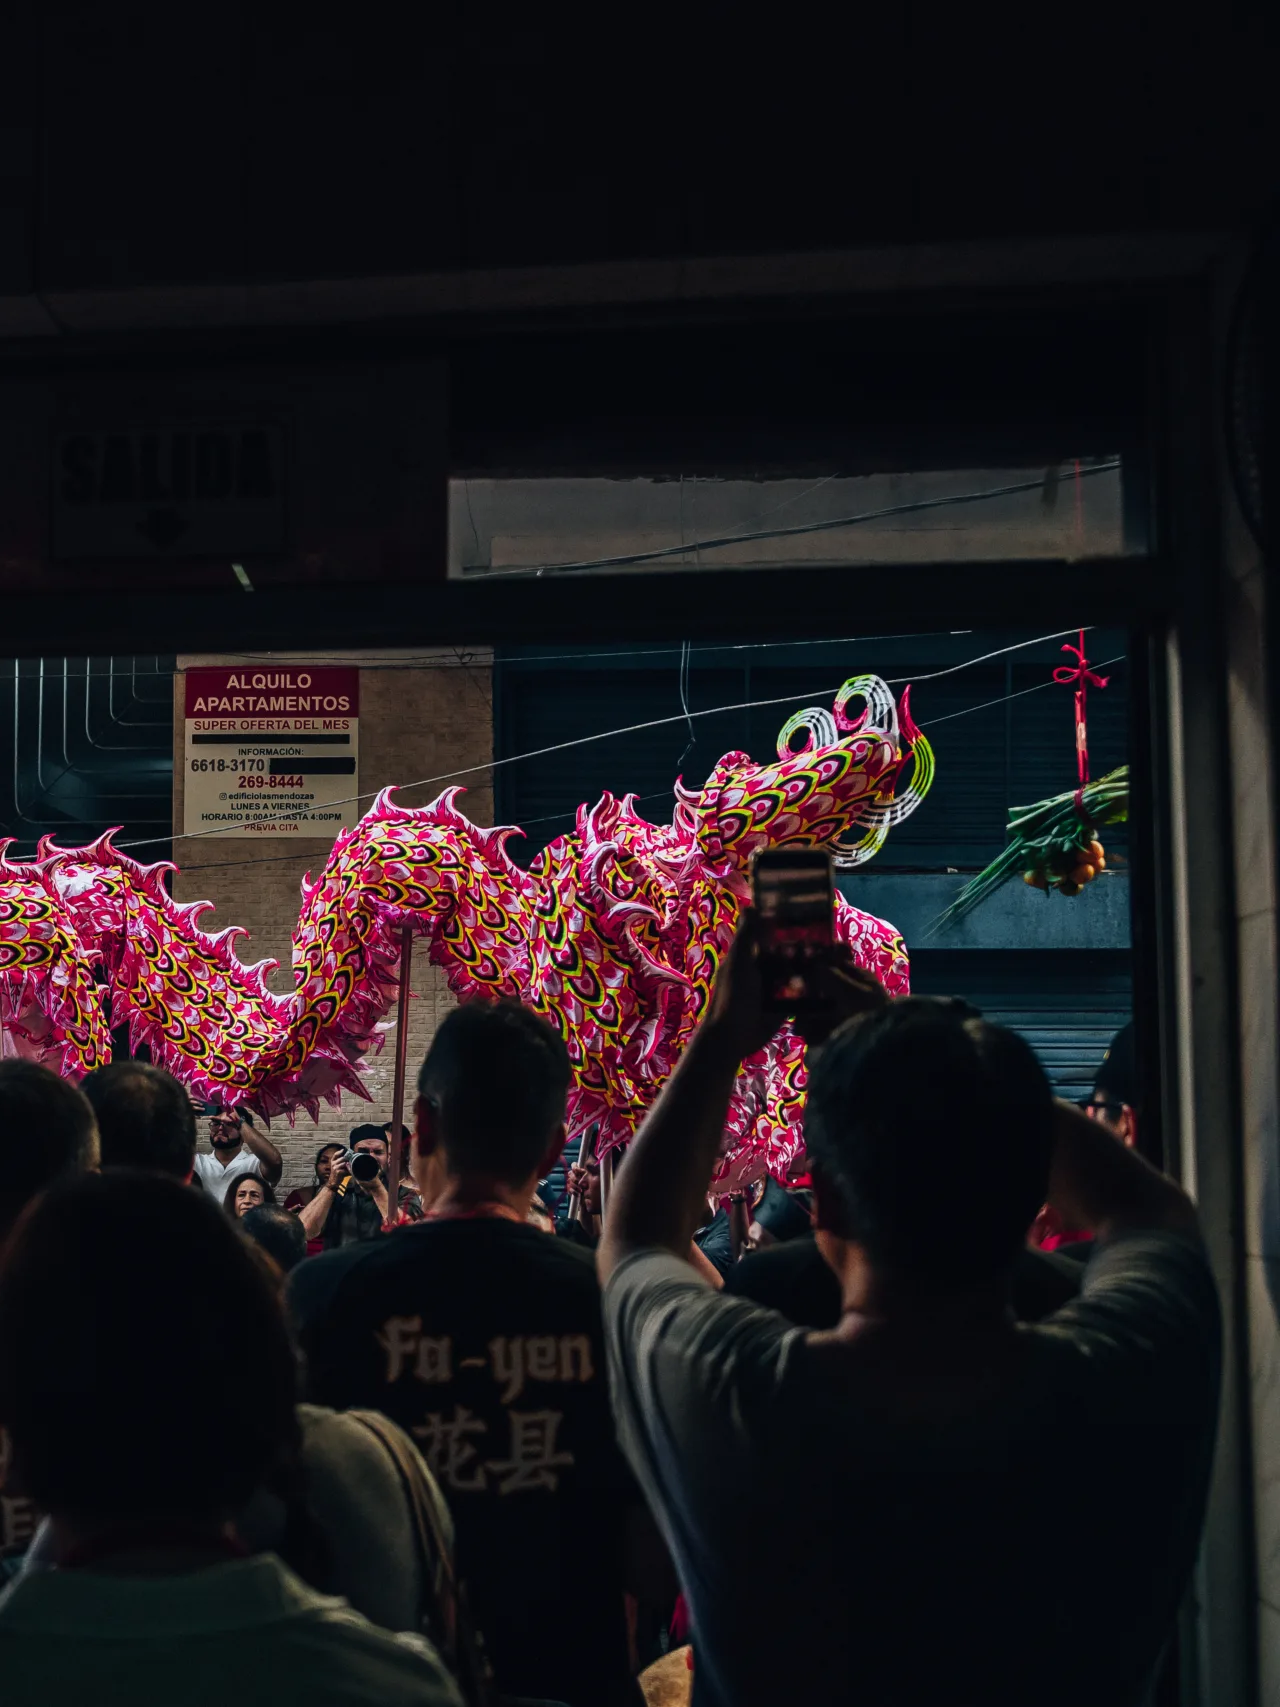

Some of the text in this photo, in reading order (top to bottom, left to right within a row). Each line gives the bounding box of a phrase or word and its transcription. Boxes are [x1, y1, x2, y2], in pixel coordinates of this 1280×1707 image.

[61, 430, 273, 504] SALIDA
[226, 673, 312, 690] ALQUILO
[193, 696, 350, 712] APARTAMENTOS
[194, 719, 350, 731] SUPER OFERTA DEL MES
[238, 747, 304, 756] INFORMACIÓN:
[191, 758, 265, 772] 6618-3170
[238, 775, 304, 789] 269-8444
[231, 803, 261, 811] LUNES
[271, 802, 310, 810] VIERNES
[201, 813, 243, 821] HORARIO
[310, 813, 342, 821] 4:00PM
[244, 823, 299, 831] PREVIA CITA
[373, 1312, 597, 1405] Fa-yen
[412, 1402, 576, 1497] 花县
